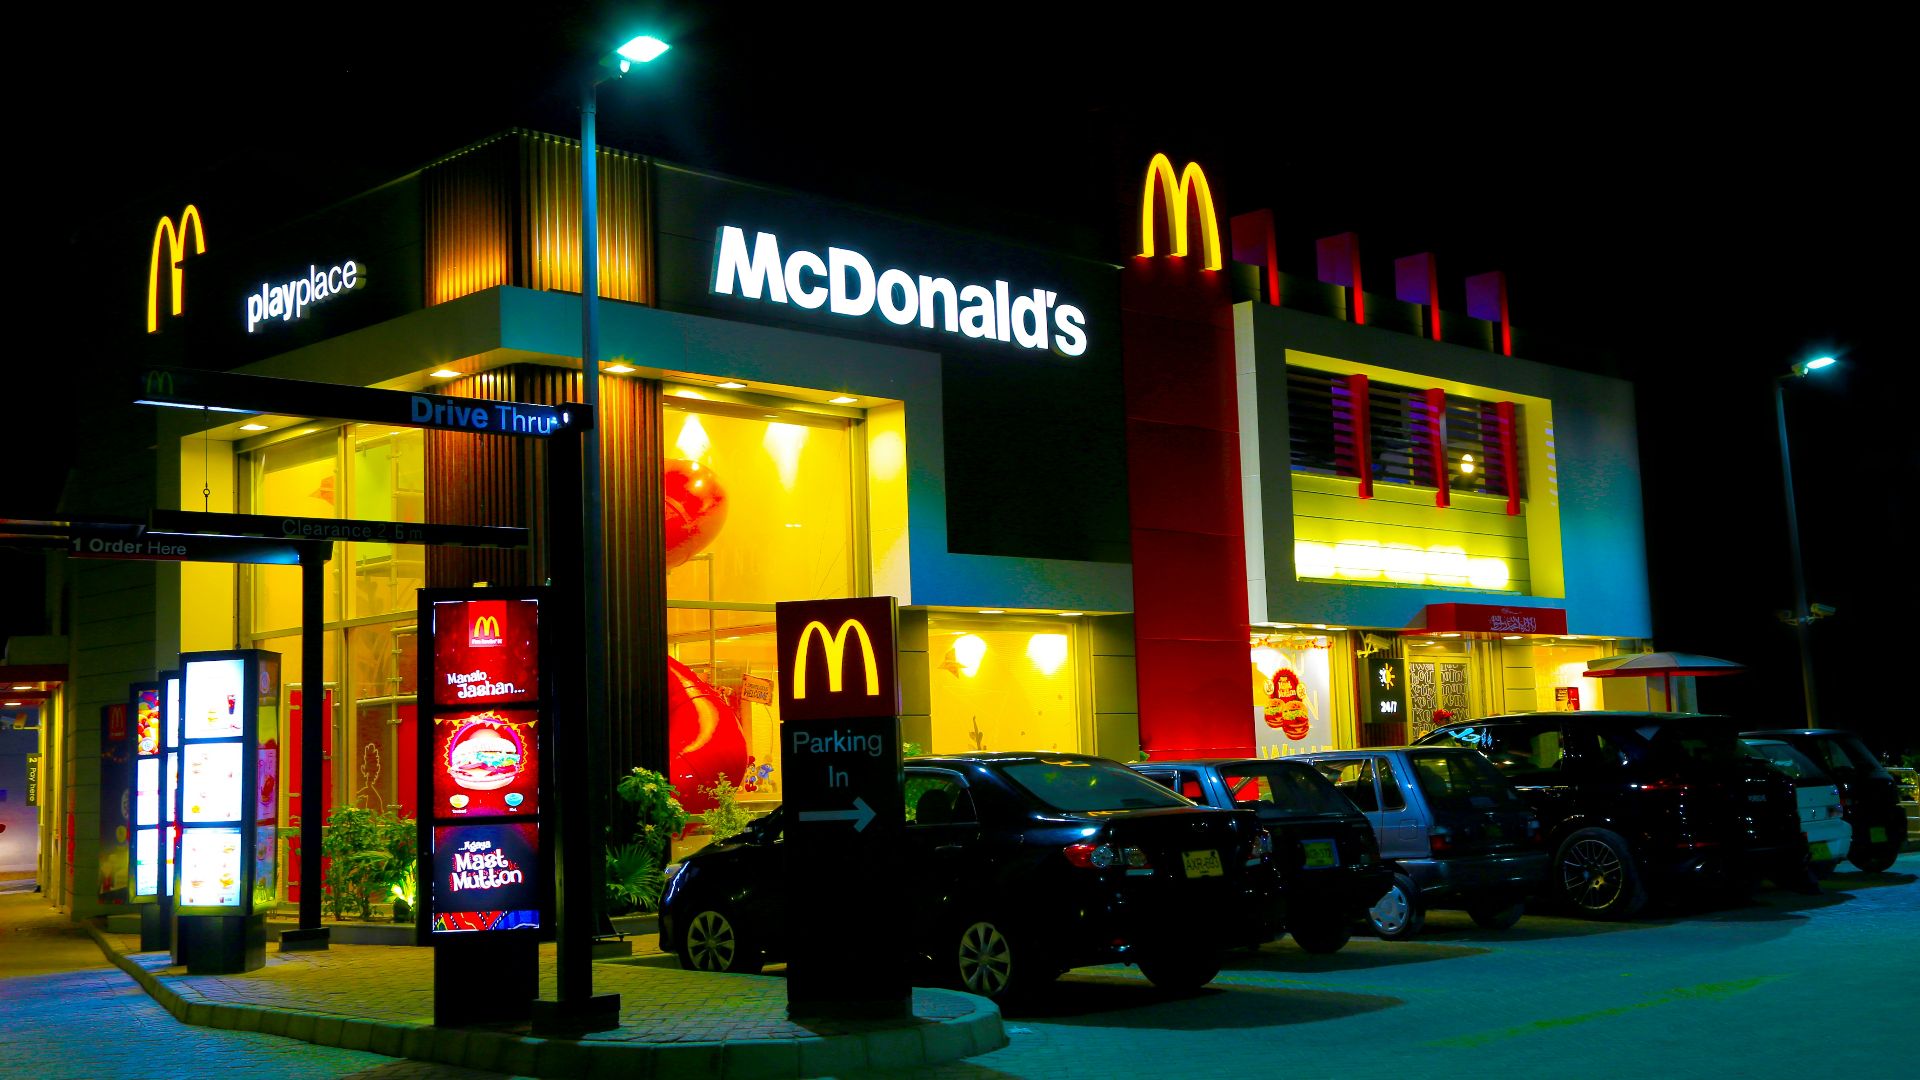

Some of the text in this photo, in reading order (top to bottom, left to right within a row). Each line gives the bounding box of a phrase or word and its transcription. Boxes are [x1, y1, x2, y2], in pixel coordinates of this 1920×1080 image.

[248, 260, 358, 333] playplace
[711, 225, 1087, 357] McDonald's
[411, 395, 552, 434] Drive Thru
[281, 518, 373, 537] Clearance
[72, 537, 188, 556] 1 Order Here
[446, 670, 487, 685] Manalo
[1380, 701, 1398, 713] 24/7
[792, 729, 884, 787] Parking In
[454, 848, 509, 873] Mast
[451, 868, 522, 892] Mutton
